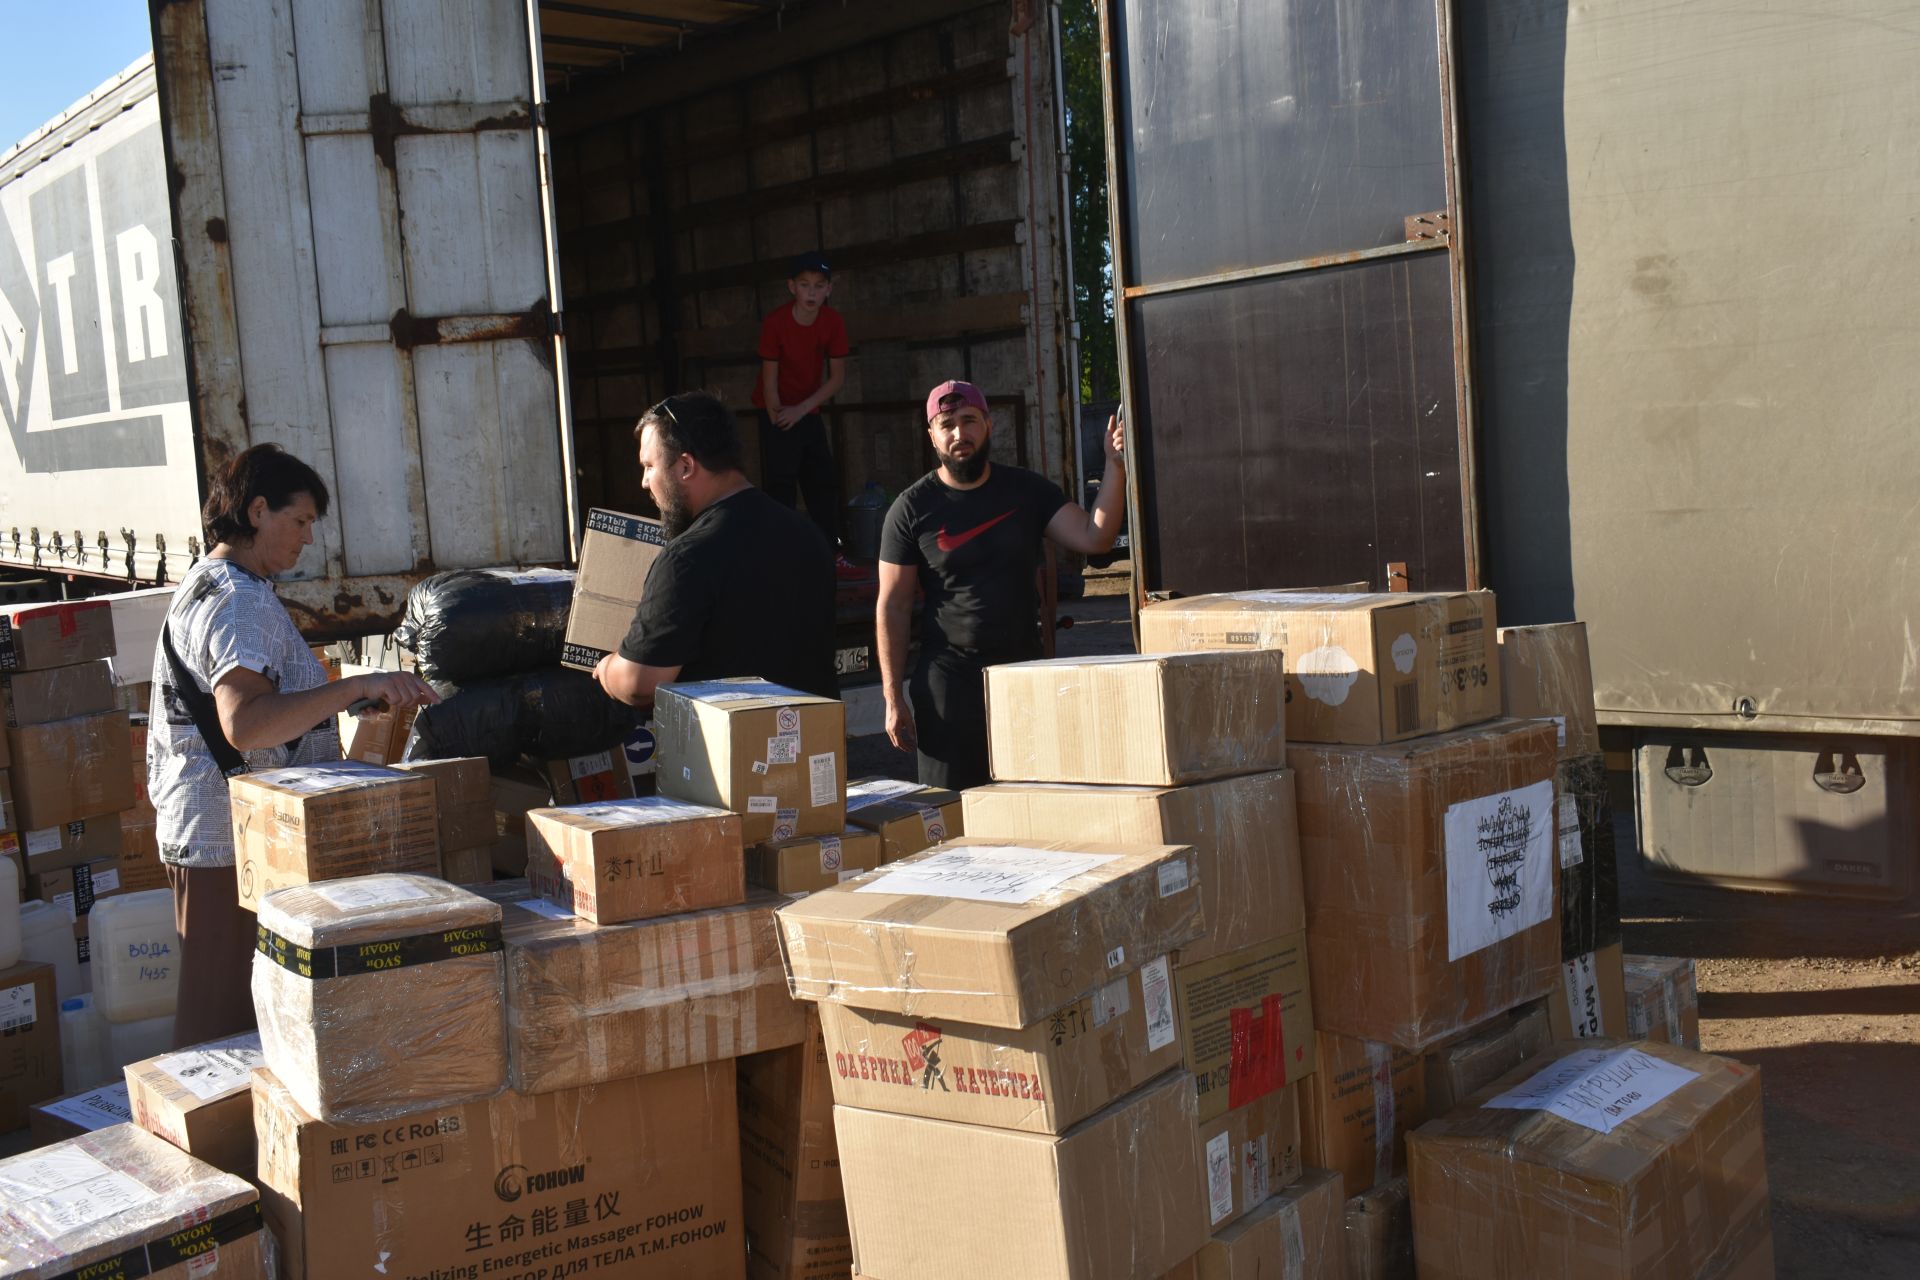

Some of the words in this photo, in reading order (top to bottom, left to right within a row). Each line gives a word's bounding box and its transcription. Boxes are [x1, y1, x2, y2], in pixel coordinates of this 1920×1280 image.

[590, 512, 628, 528] КРУТЫХ
[563, 644, 601, 659] КРУТЫХ
[848, 649, 864, 665] 16
[128, 942, 170, 958] ВОДА
[359, 941, 401, 957] ЛЮДИ
[139, 966, 169, 980] 1435
[1584, 984, 1599, 1037] MyD
[835, 1050, 914, 1086] ФАБРИКА
[1566, 1054, 1659, 1109] ИГРУШКИ
[952, 1066, 1045, 1101] КАЧЕСТВА
[410, 1116, 460, 1141] RoHS
[526, 1164, 586, 1194] FOHOW
[464, 1190, 621, 1252] 生命能量仪
[170, 1223, 213, 1248] ЛЮДИ
[482, 1242, 562, 1273] Energetic
[567, 1224, 643, 1251] Massager
[645, 1205, 704, 1228] FOHOW
[552, 1256, 589, 1280] ДЛЯ
[593, 1246, 636, 1269] ТЕЛА
